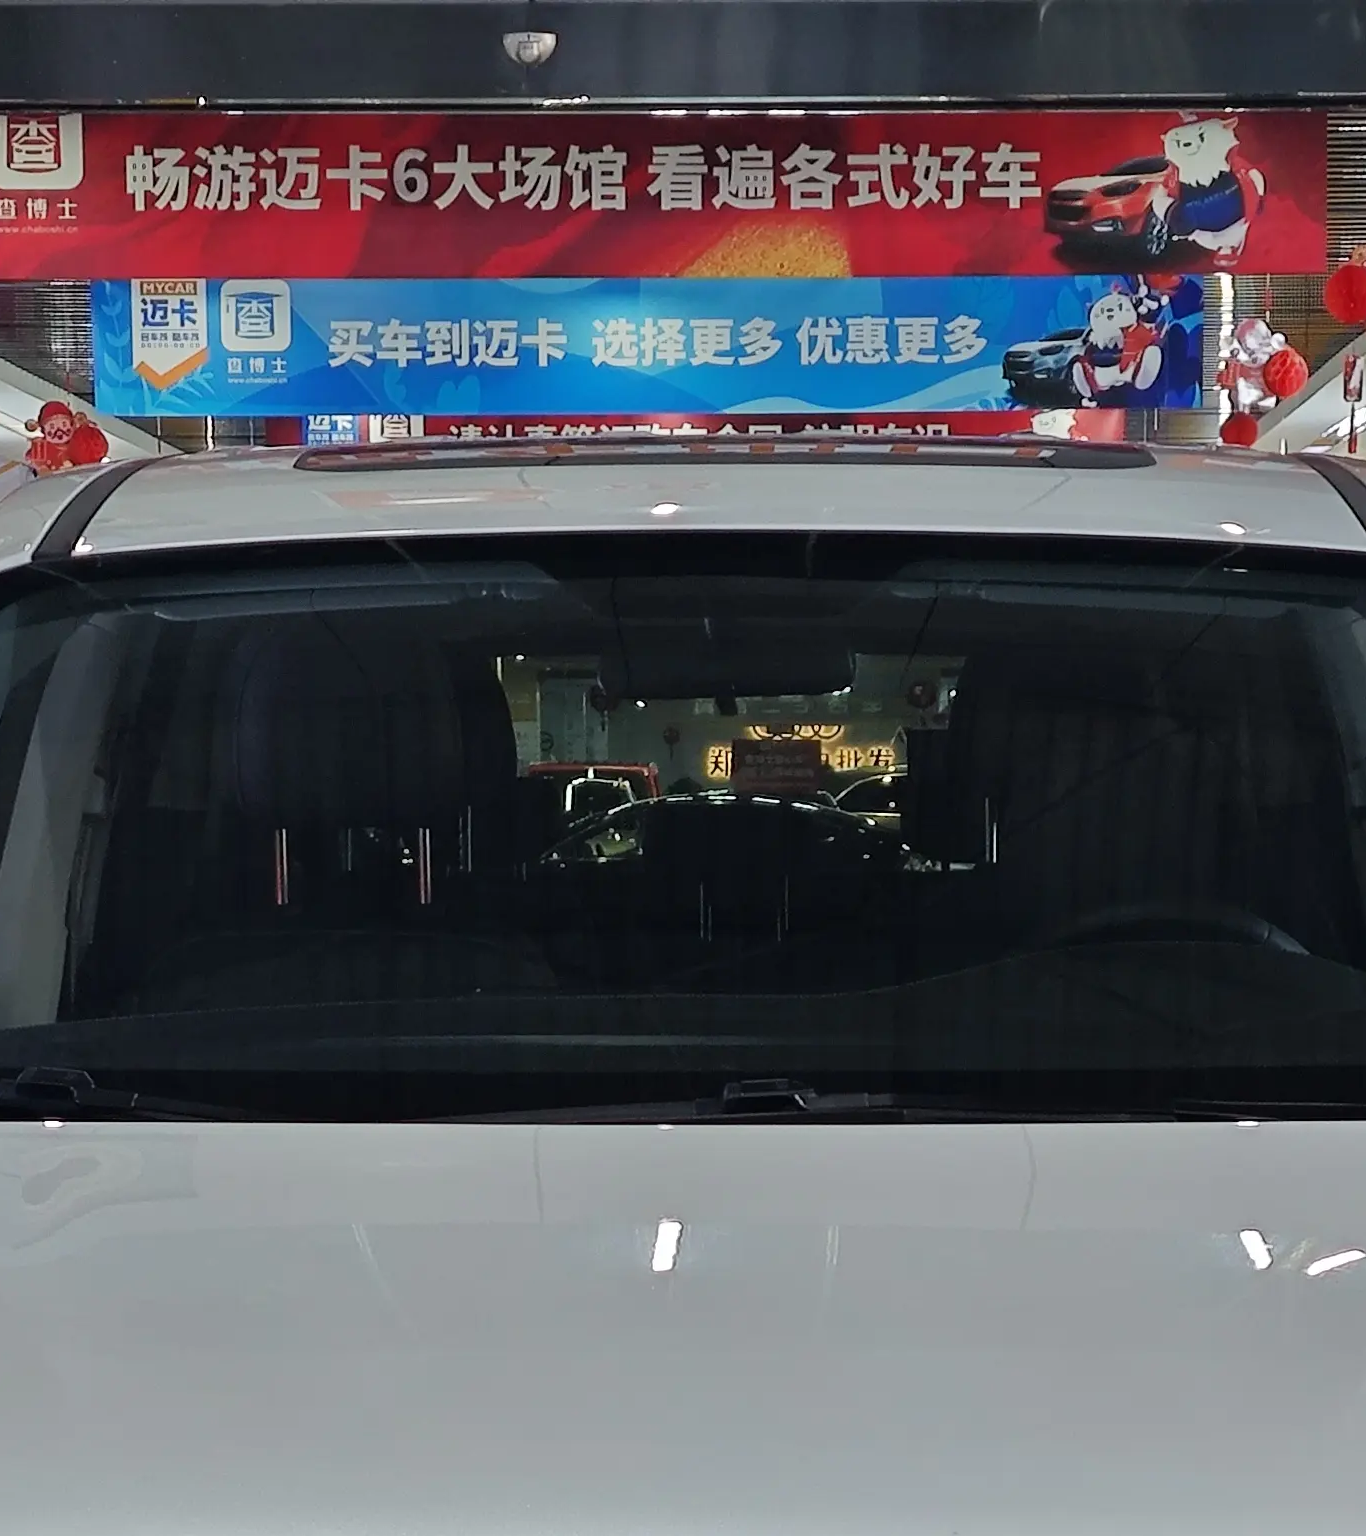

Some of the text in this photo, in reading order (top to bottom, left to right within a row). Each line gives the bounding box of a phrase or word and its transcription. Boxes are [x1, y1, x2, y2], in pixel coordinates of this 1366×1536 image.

[124, 143, 1043, 212] 畅游迈卡6大场馆 看遍各式好车
[143, 282, 195, 294] MYCAR
[140, 298, 197, 327] 迈卡
[328, 316, 989, 368] 买车到迈卡 选择更多 优惠更多
[227, 357, 287, 374] 查博士
